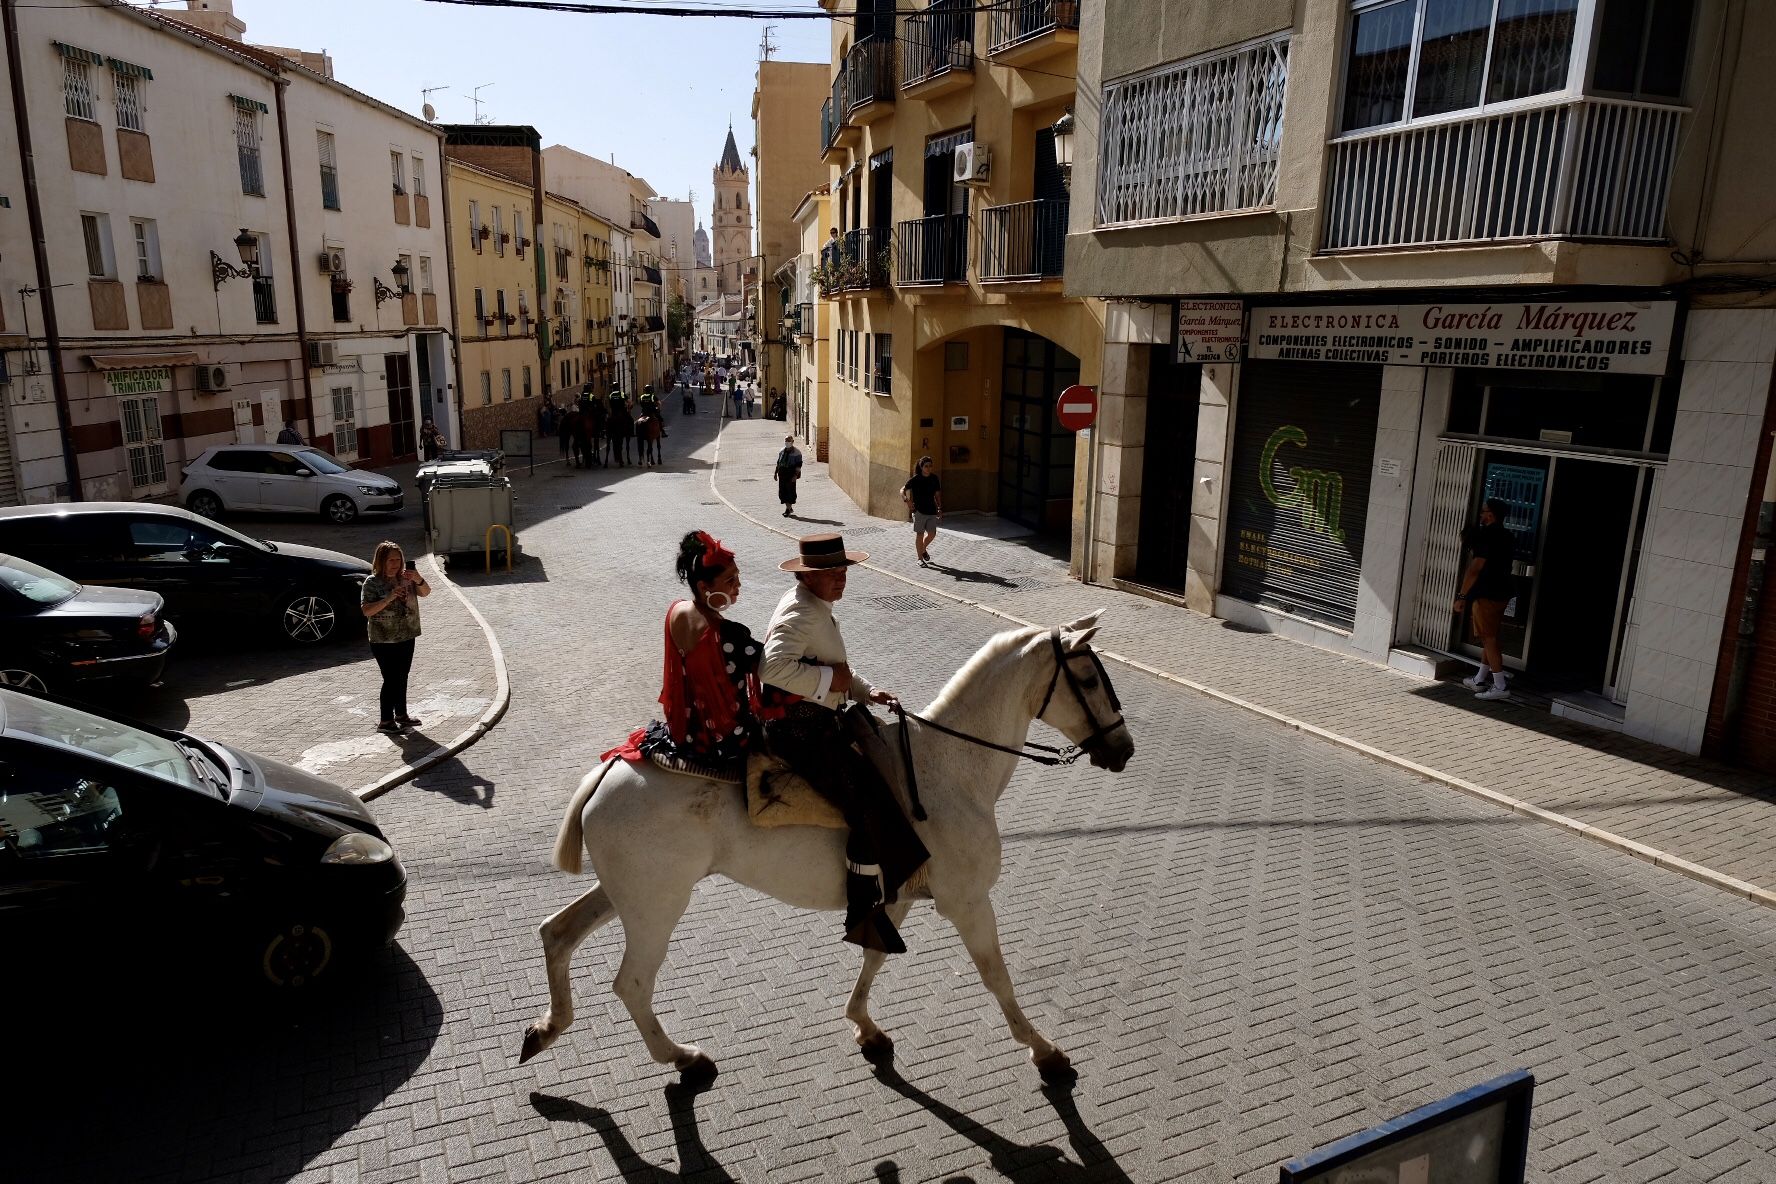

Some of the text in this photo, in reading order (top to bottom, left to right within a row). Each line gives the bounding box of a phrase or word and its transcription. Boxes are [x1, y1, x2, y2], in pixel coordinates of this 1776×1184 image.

[1181, 302, 1241, 311] ELECTRONICA
[1180, 315, 1241, 328] García Márquez
[1269, 305, 1638, 338] ELECTRONICA García Márquez
[1258, 335, 1327, 347] COMPONENTES
[1332, 336, 1413, 349] ELECTRONICOS
[1433, 337, 1488, 350] SONIDO
[1510, 338, 1652, 355] AMPLIFICADORES
[1278, 347, 1321, 360] ANTENAS
[1325, 348, 1389, 362] COLECTIVAS
[1420, 351, 1490, 366] PORTEROS
[1495, 352, 1610, 371] ELECTRONICOS
[1209, 368, 1215, 381] 3
[112, 380, 162, 394] TRINITARIA
